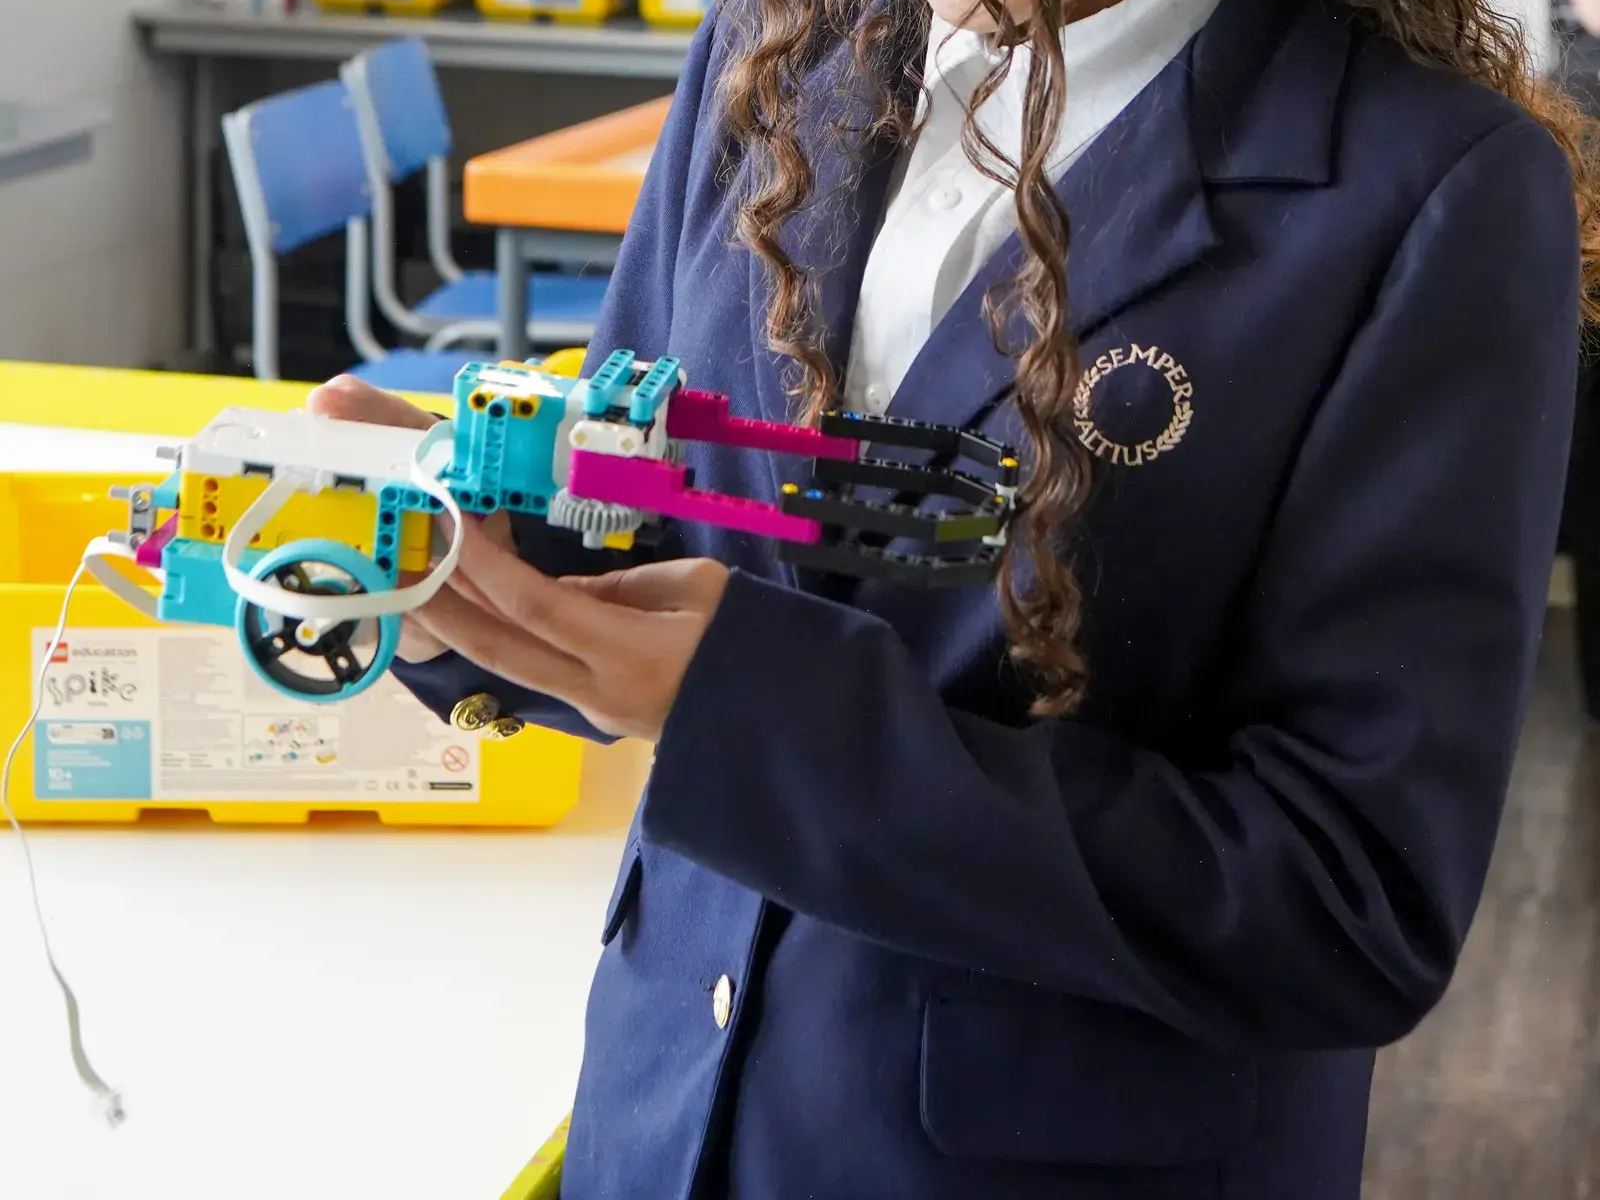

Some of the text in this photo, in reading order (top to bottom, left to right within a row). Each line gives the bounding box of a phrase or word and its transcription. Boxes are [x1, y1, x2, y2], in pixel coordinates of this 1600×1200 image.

[1095, 343, 1194, 405] SEMPER
[1074, 419, 1159, 466] ALTIUS
[72, 647, 137, 657] education
